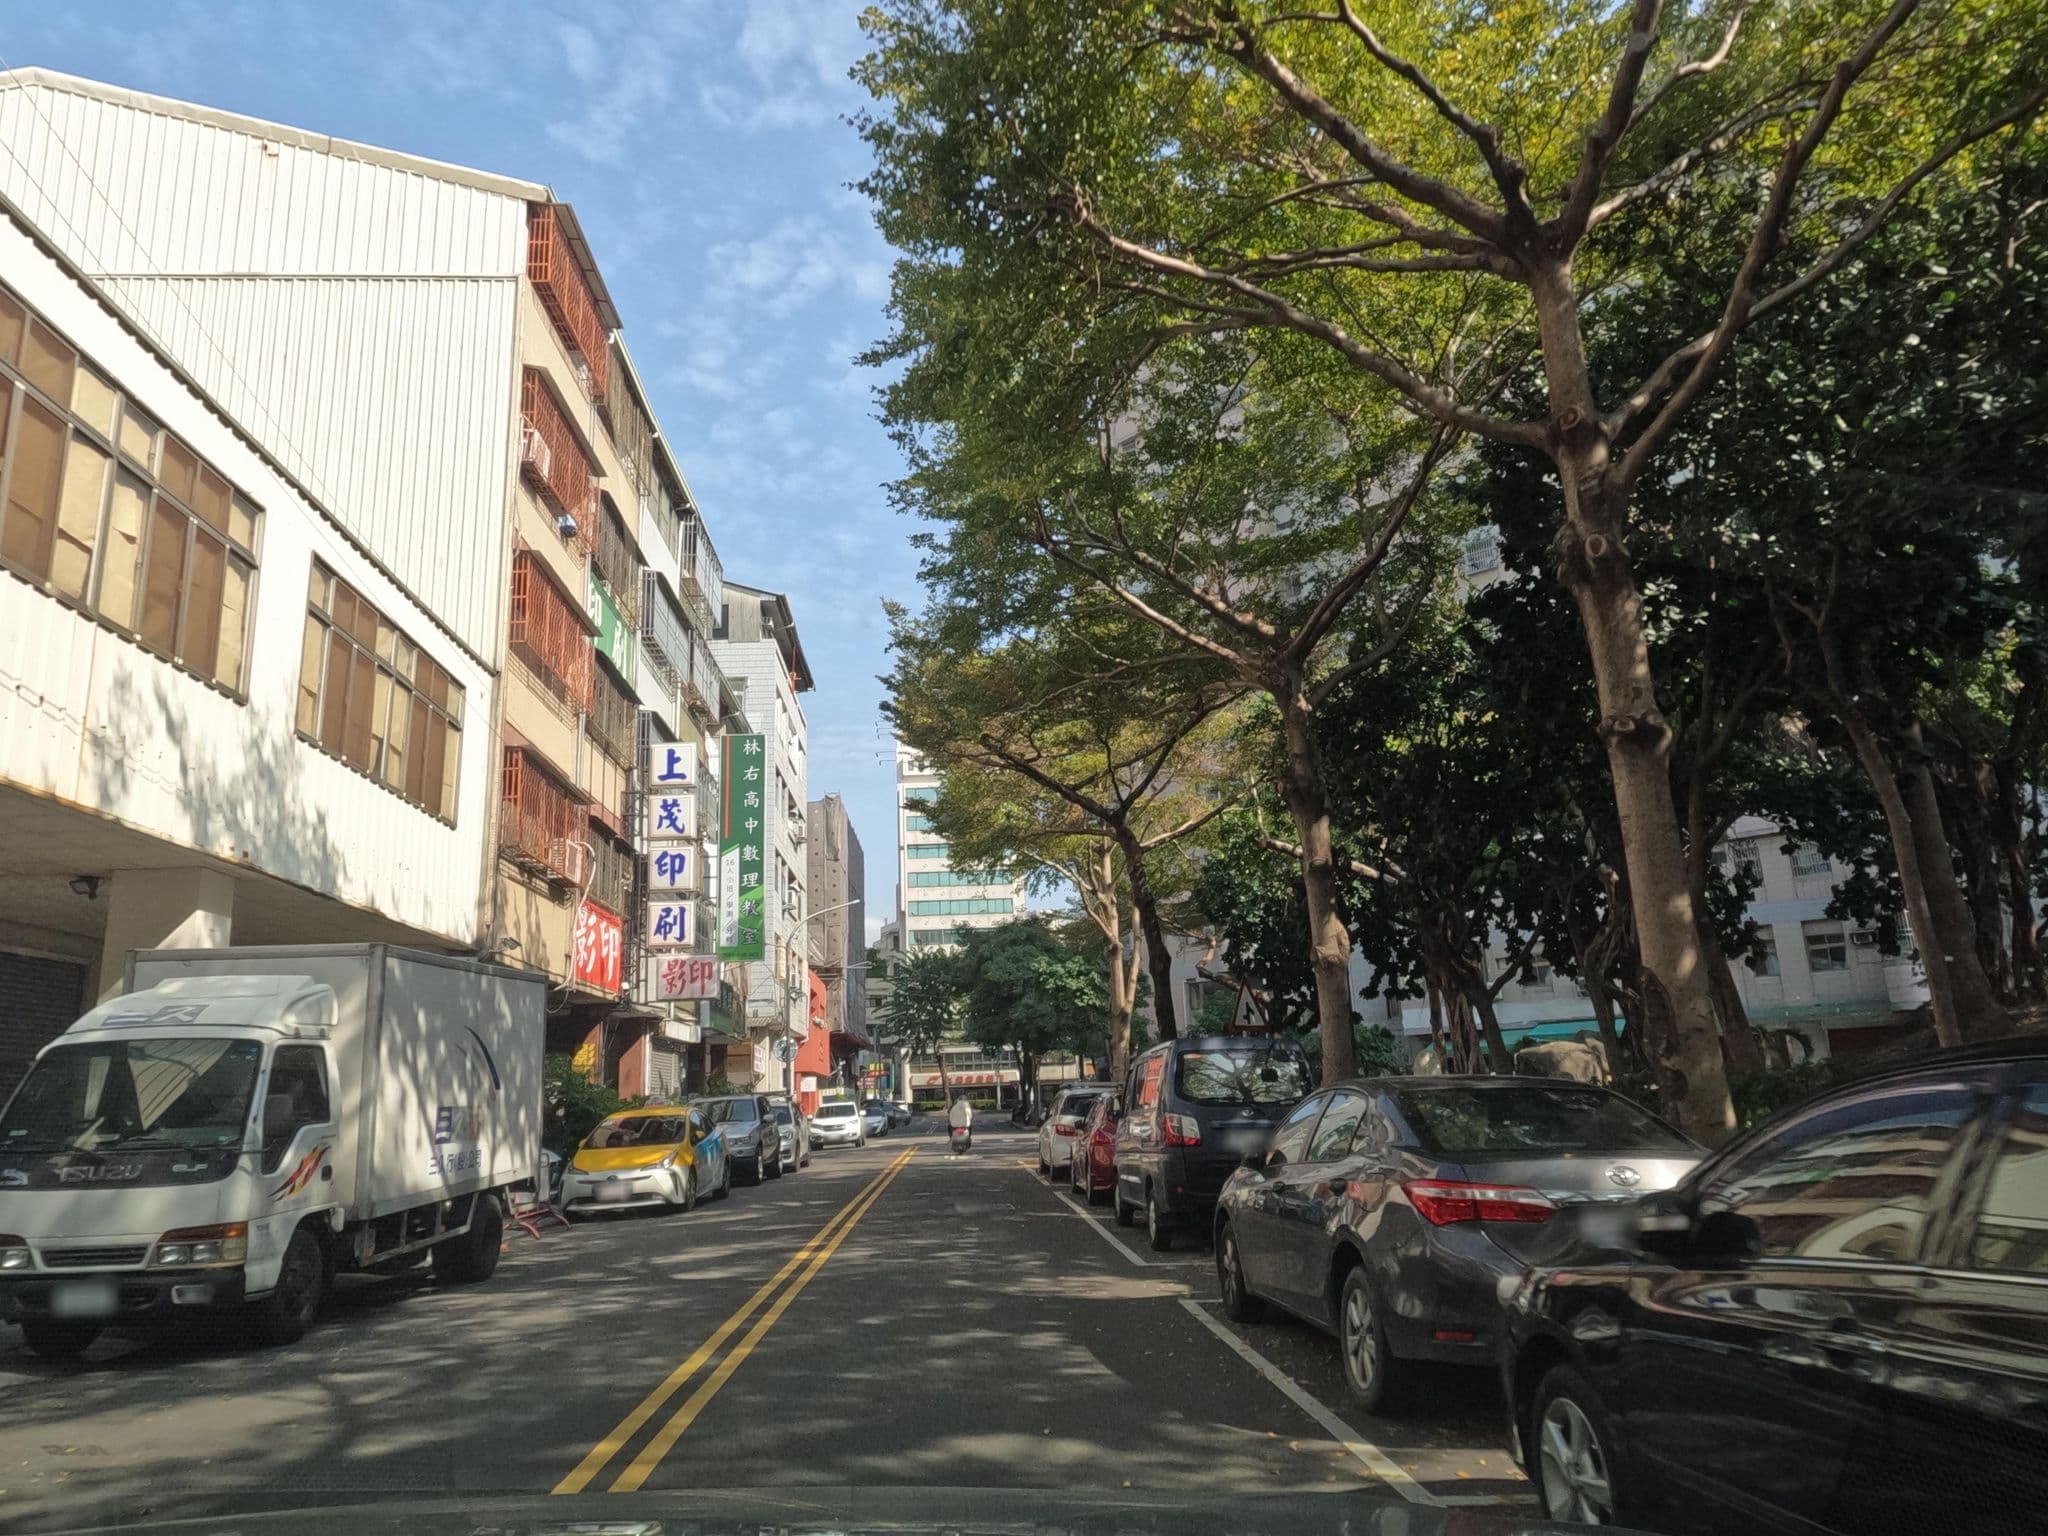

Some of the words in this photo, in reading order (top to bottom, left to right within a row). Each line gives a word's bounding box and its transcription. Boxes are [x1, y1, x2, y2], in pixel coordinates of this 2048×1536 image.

[654, 748, 688, 943] 上茂印刷
[741, 738, 762, 945] 林右高中數理教室
[576, 906, 620, 982] 影印
[662, 958, 713, 996] 影印
[57, 1163, 144, 1183] ISUZU
